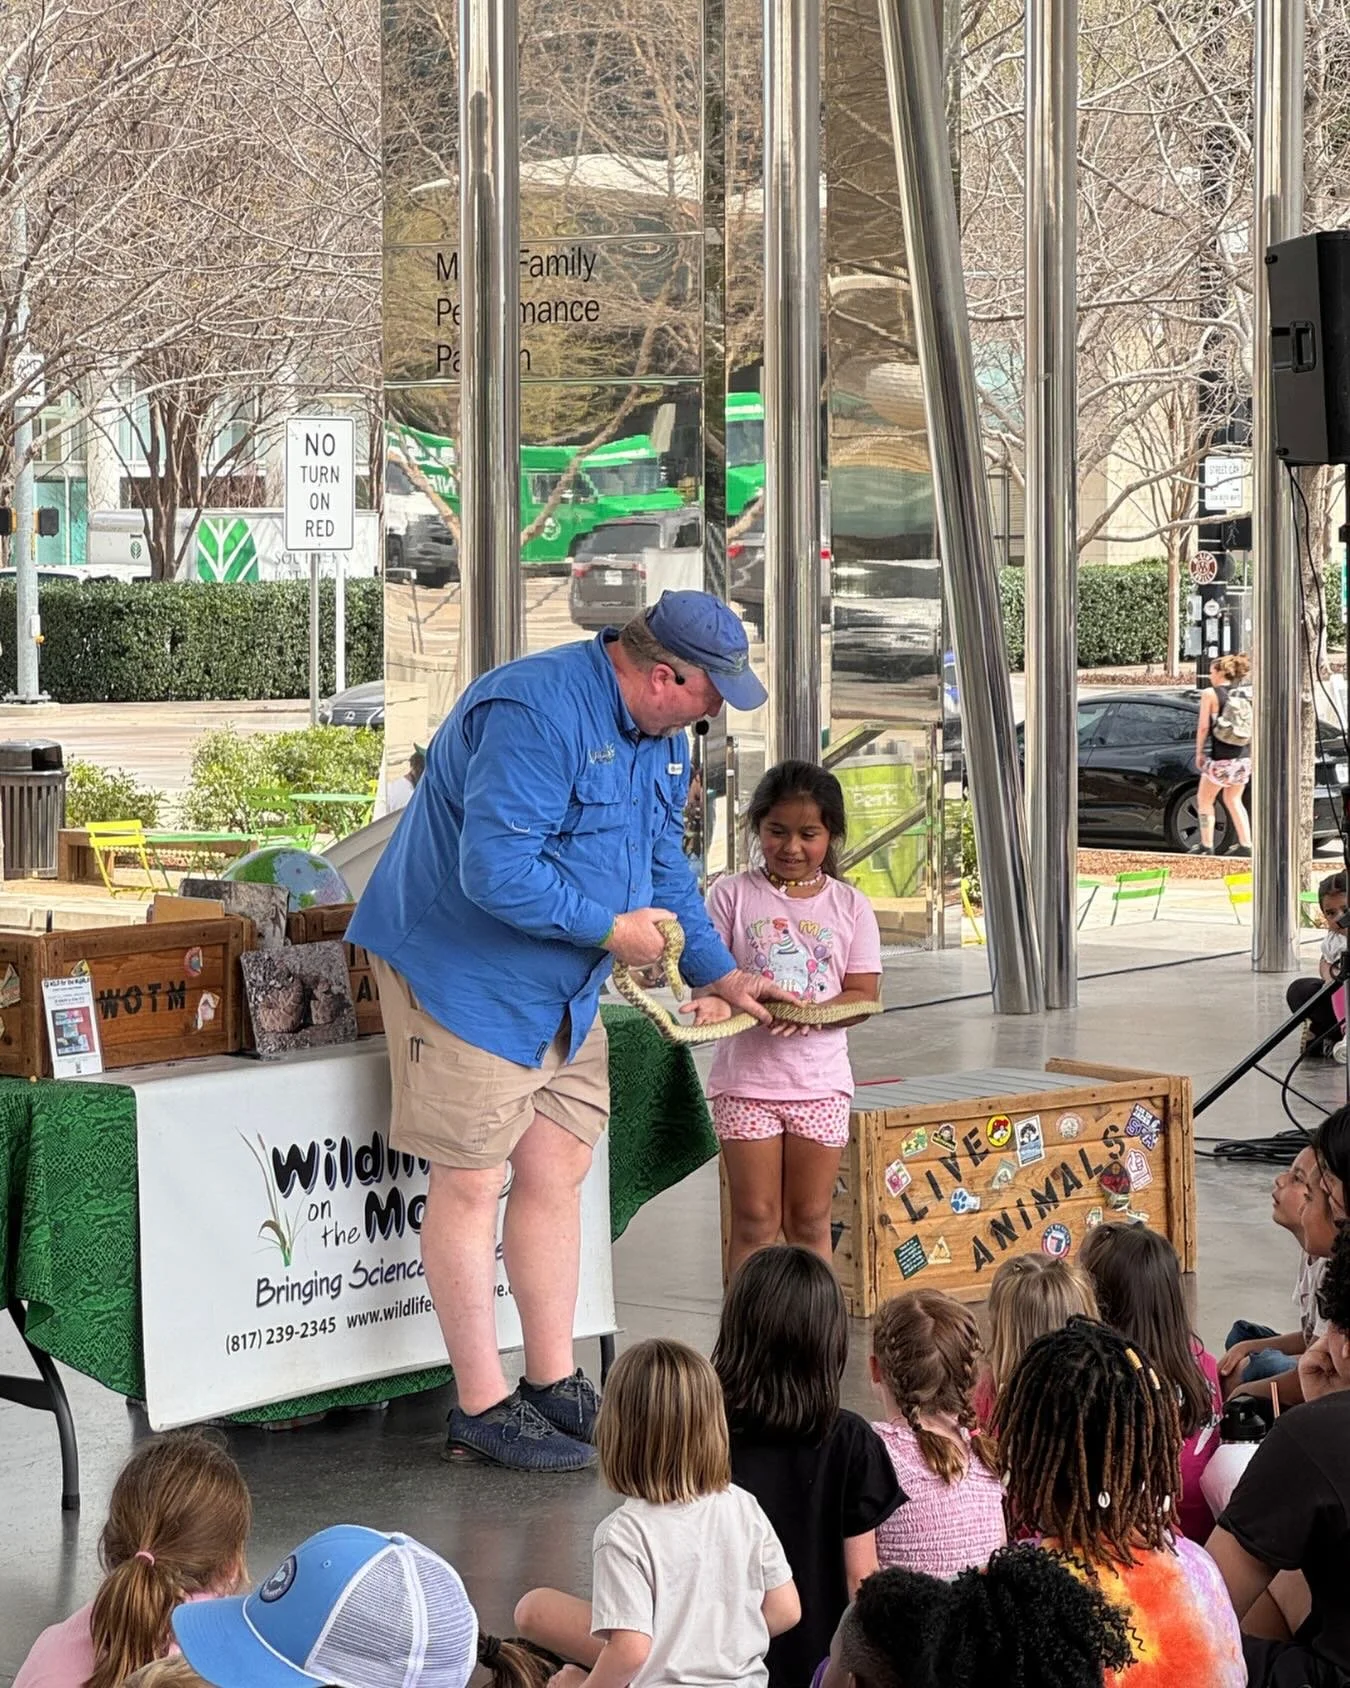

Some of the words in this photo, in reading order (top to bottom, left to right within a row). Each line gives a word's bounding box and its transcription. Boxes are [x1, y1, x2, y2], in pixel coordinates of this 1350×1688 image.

[305, 433, 336, 457] NO
[300, 465, 340, 484] TURN
[309, 492, 331, 511] ON
[305, 519, 335, 538] RED
[99, 980, 186, 1019] WOTM
[271, 1129, 432, 1199] Wildli
[899, 1126, 991, 1224] LIVE
[307, 1199, 332, 1222] on
[971, 1123, 1126, 1273] ANIMALS
[321, 1221, 361, 1249] the
[256, 1270, 343, 1308] Bringing
[225, 1328, 263, 1355] (817)
[265, 1316, 337, 1345] 239-2345
